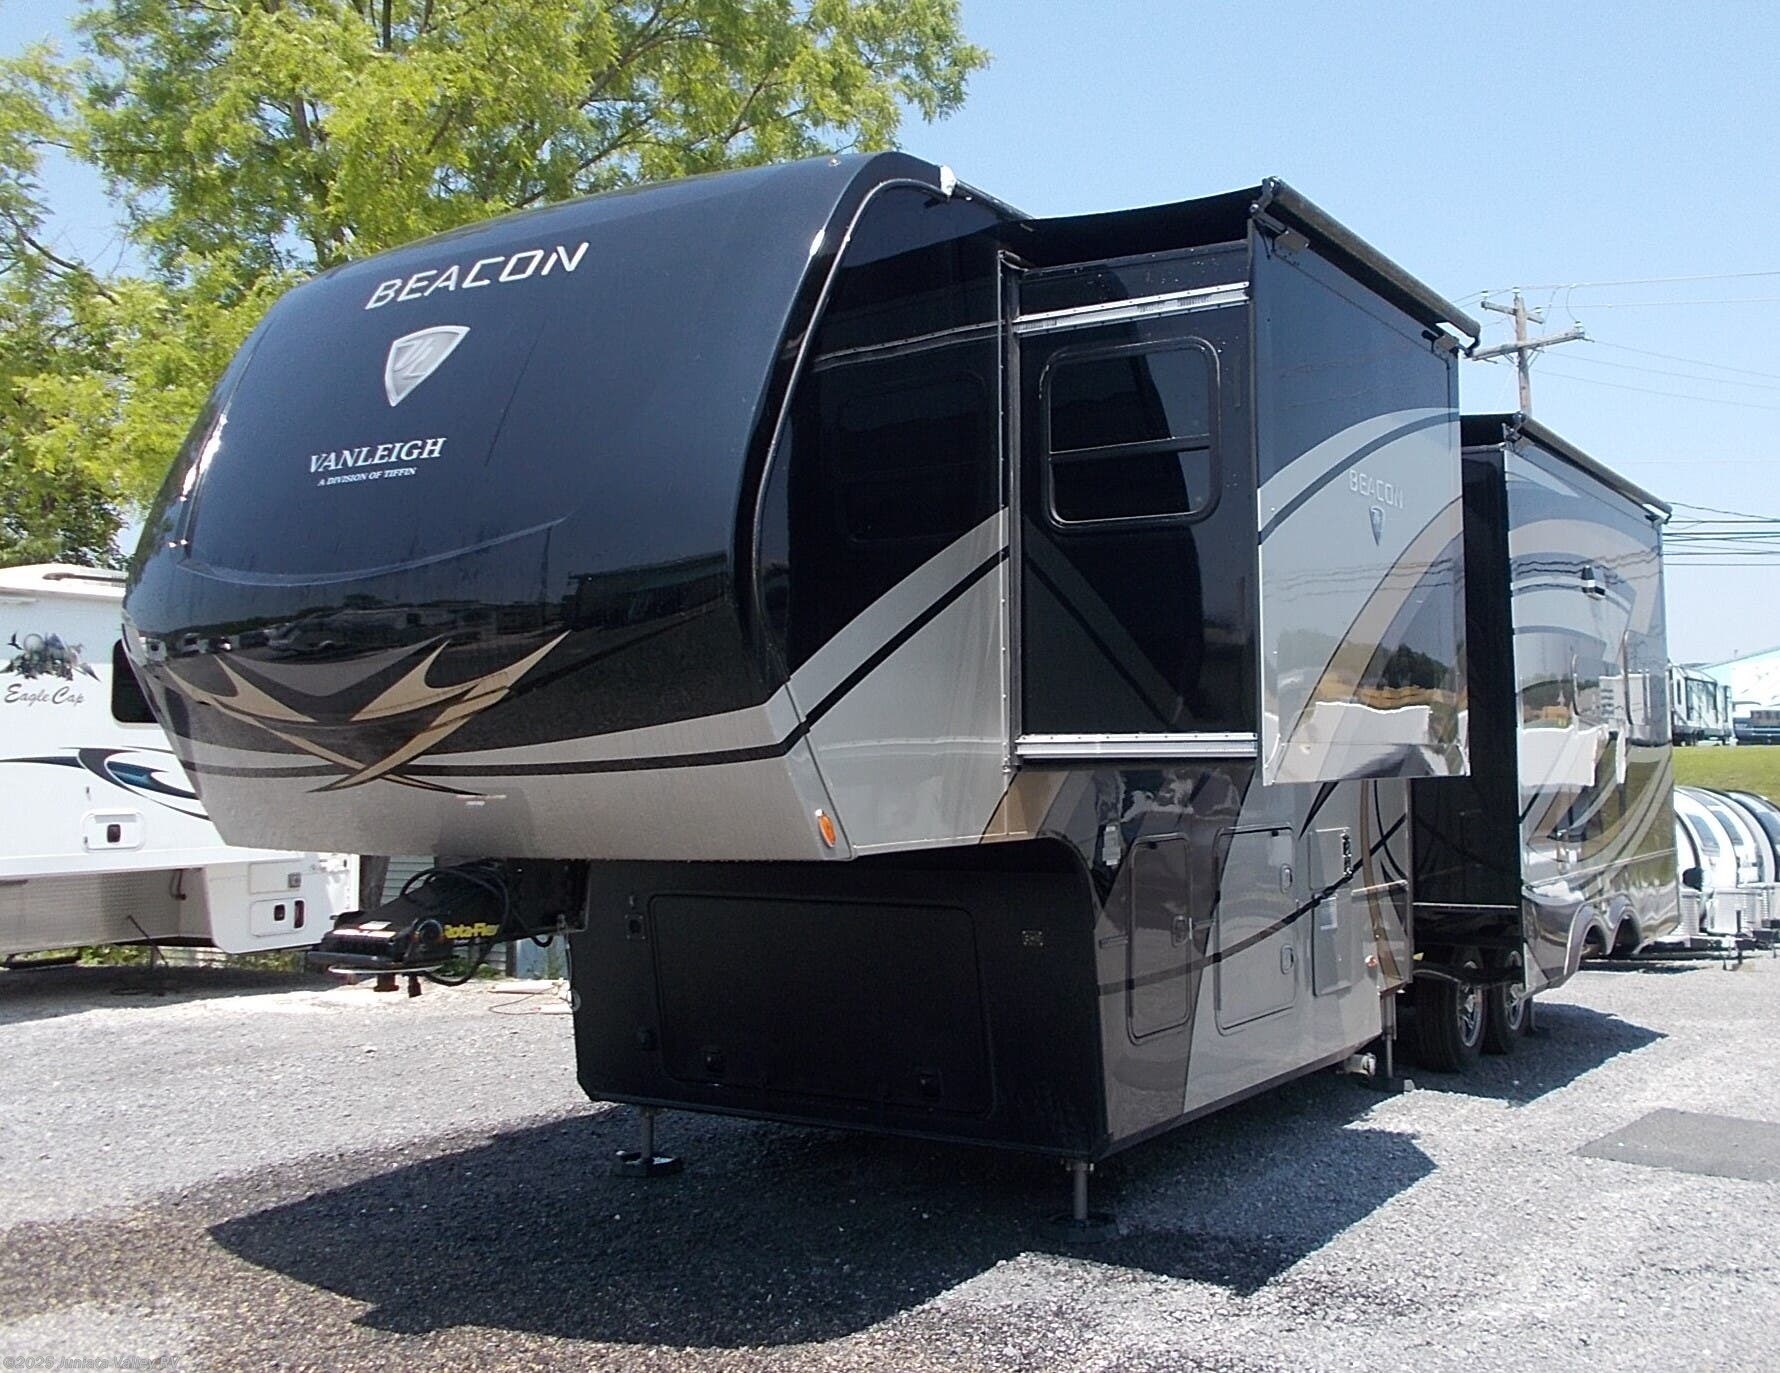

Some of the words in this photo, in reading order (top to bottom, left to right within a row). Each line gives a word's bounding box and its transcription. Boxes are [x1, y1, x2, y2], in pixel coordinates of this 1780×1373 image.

[365, 242, 590, 310] BEACON
[310, 437, 448, 473] VANLEIGH
[317, 478, 326, 487] A
[326, 472, 367, 486] DIVISION
[368, 470, 383, 480] OF
[384, 466, 417, 478] TIFFIN
[1349, 468, 1404, 509] BEACON
[4, 683, 50, 707] Eagle
[52, 685, 85, 707] Cap
